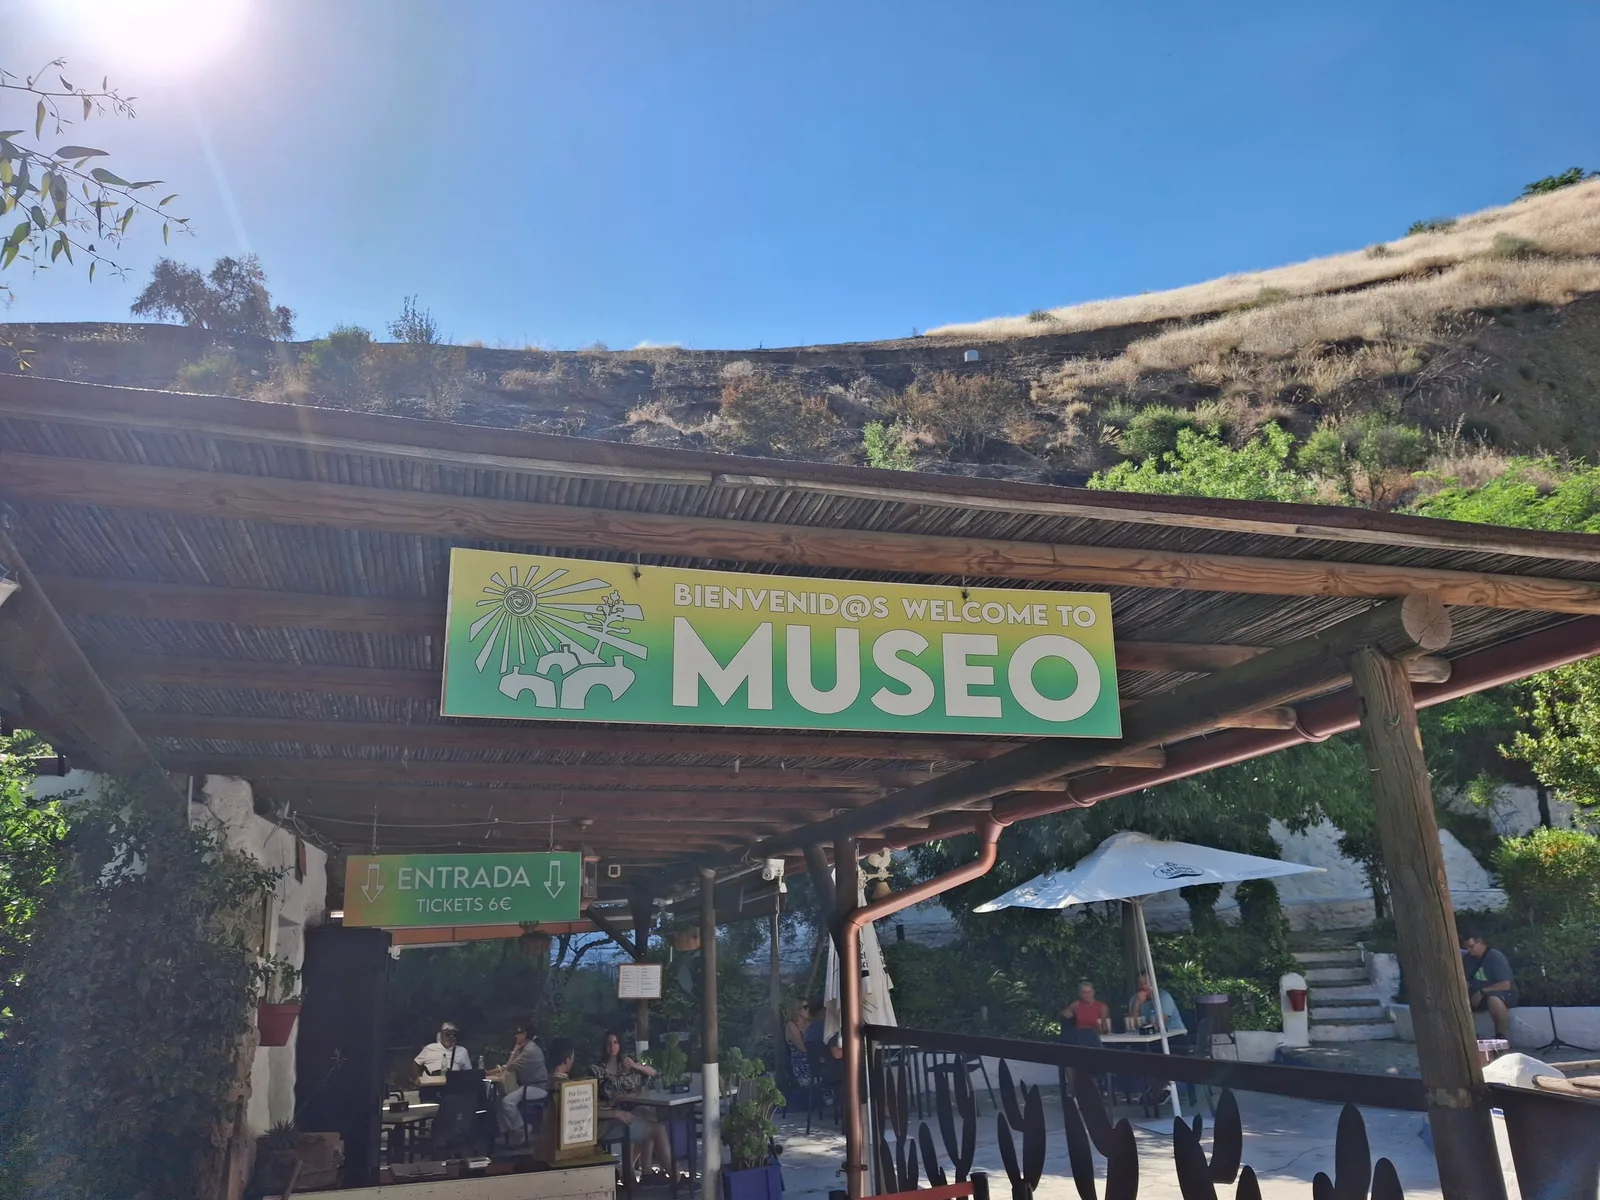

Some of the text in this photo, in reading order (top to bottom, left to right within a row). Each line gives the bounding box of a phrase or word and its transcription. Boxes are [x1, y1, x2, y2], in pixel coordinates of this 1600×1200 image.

[673, 582, 1096, 628] BIENVENID@S WELCOME TO
[672, 616, 1101, 722] MUSEO
[397, 864, 531, 890] ENTRADA
[416, 896, 512, 912] TICKETS 6€
